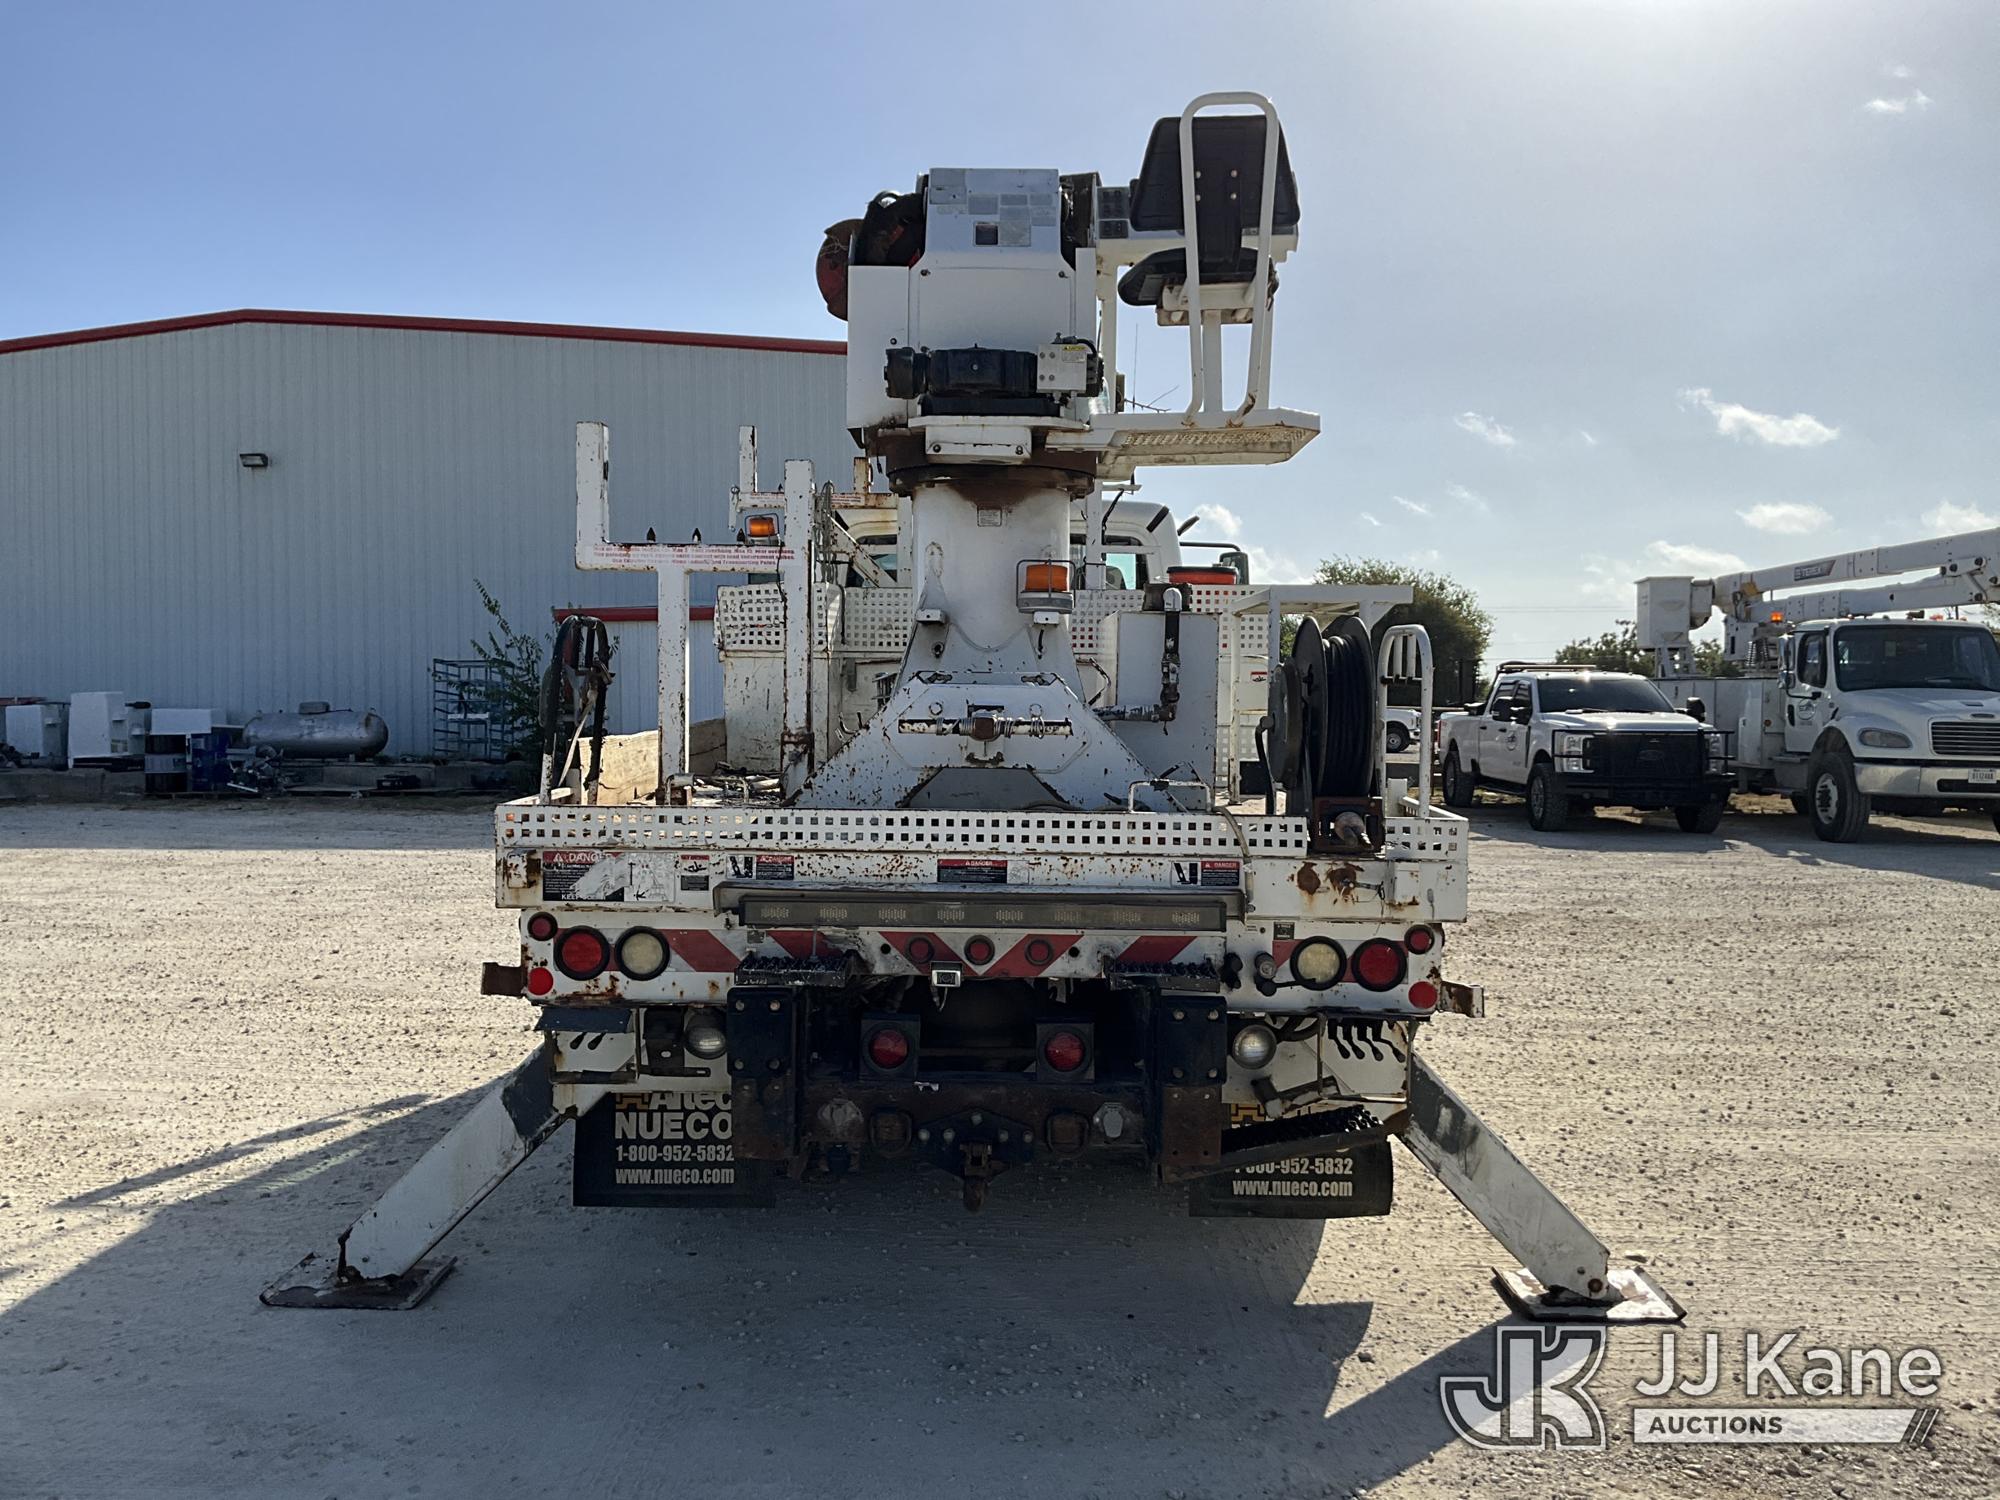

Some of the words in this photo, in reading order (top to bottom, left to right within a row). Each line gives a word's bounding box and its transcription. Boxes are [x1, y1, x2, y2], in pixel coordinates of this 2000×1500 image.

[614, 1111, 733, 1140] NUECO
[616, 1144, 735, 1162] 1-800-952-5832
[615, 1168, 735, 1185] www.nueco.com
[1232, 1180, 1353, 1197] www.nueco.com
